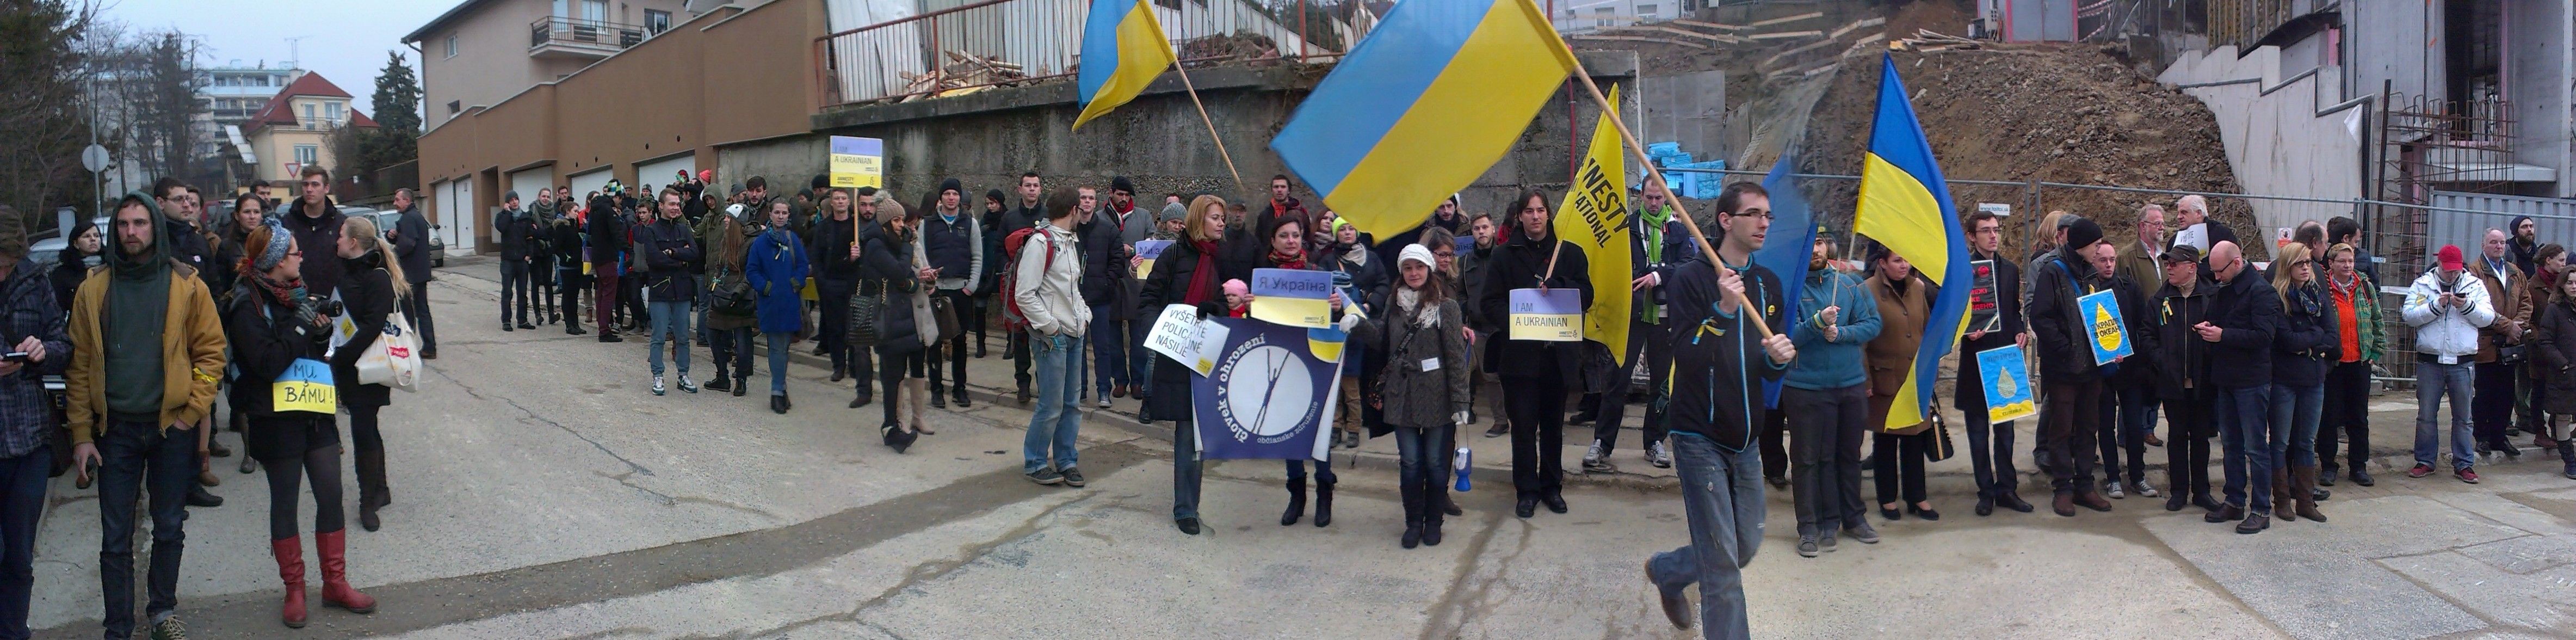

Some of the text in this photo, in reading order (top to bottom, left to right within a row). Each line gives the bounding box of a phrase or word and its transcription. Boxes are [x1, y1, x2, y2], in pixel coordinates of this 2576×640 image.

[840, 156, 872, 164] UKRAINIAN
[1583, 157, 1629, 233] NESTY
[1575, 192, 1612, 248] ATIONAL
[1259, 276, 1326, 292] Я Україна
[1516, 303, 1533, 312] I AM
[1515, 317, 1568, 327] A UKRAINIAN
[1156, 334, 1189, 358] NÁSILIE
